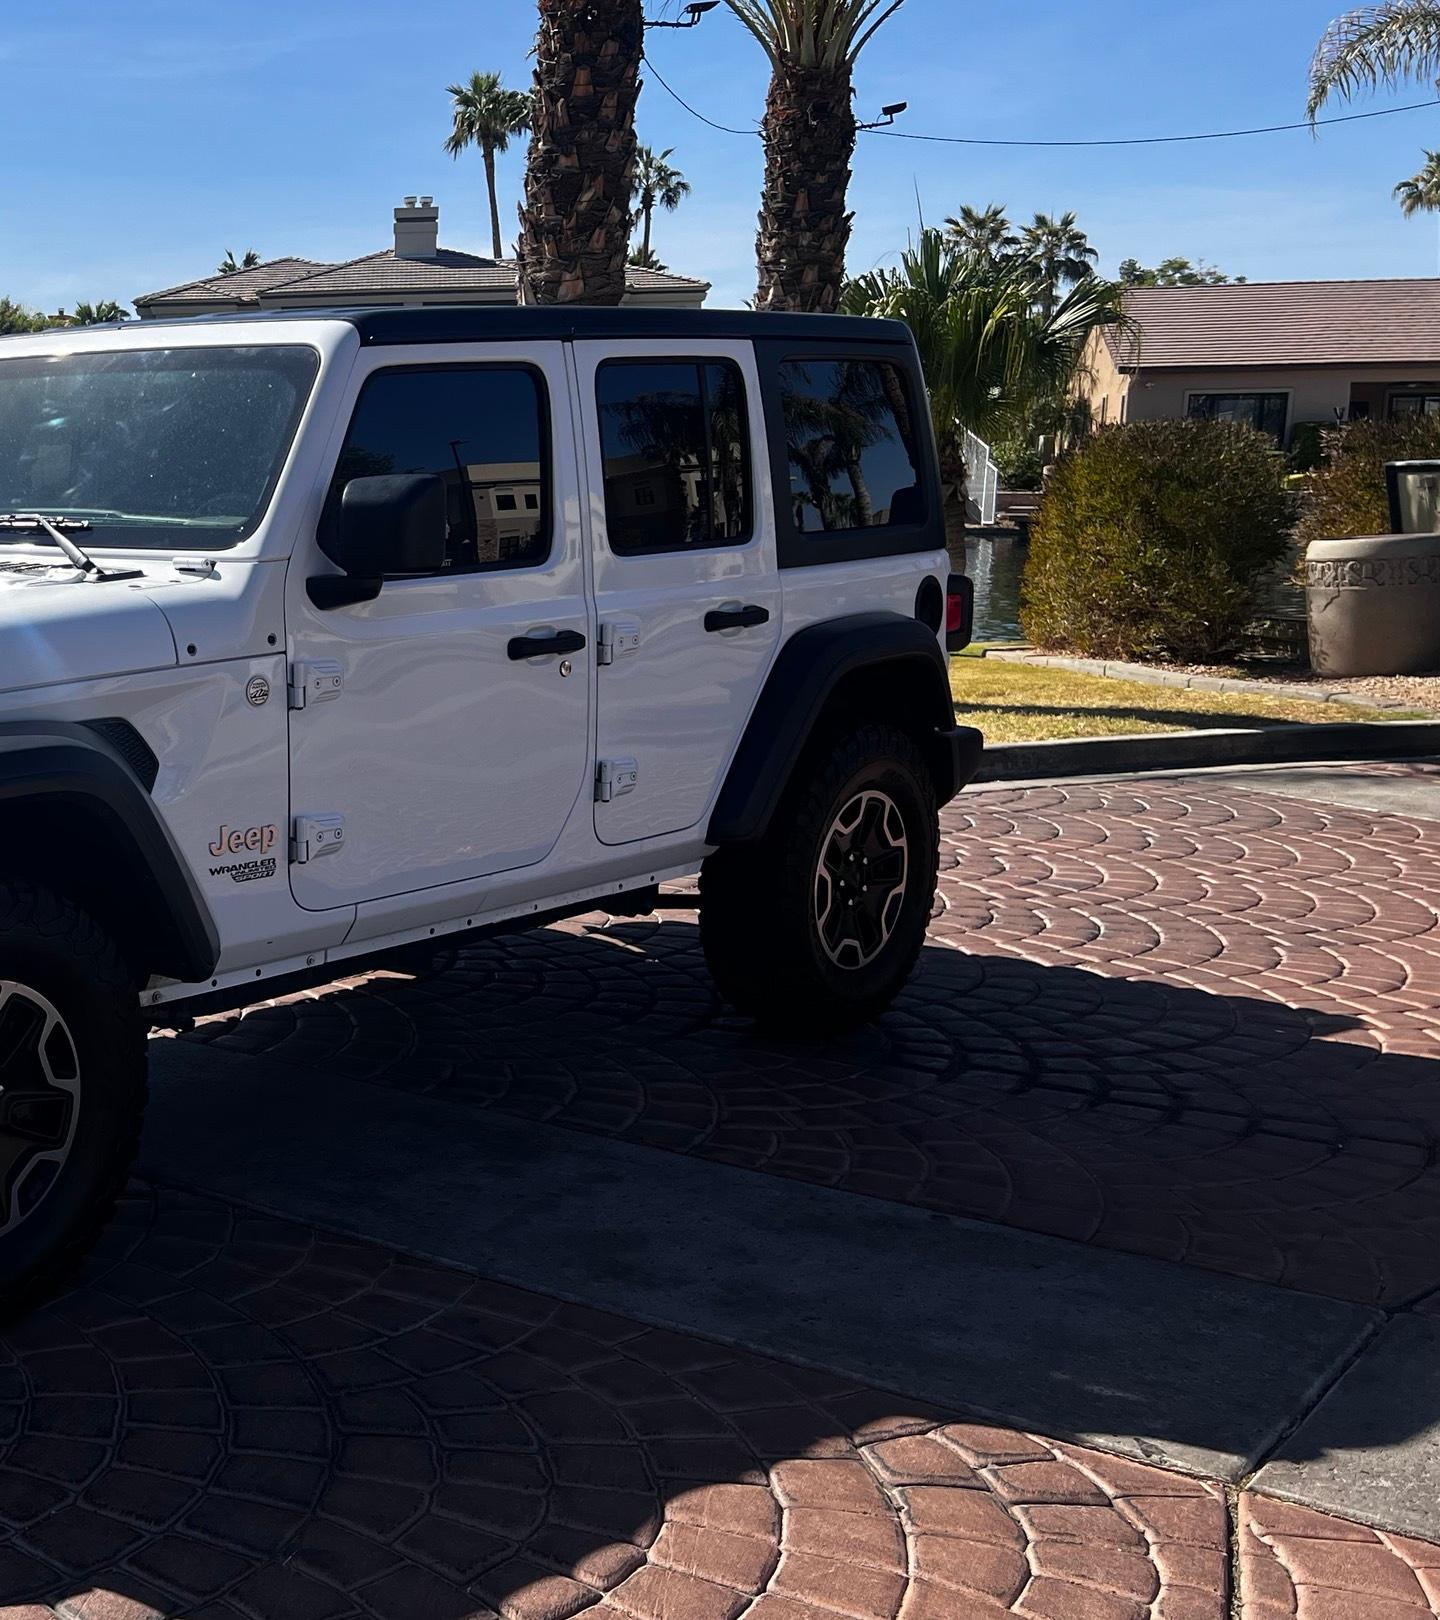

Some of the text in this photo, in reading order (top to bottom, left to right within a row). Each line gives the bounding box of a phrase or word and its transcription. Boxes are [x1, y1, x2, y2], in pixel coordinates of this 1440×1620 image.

[208, 823, 277, 857] Jeep
[209, 858, 276, 876] WRANGLER
[230, 865, 277, 877] UNLIMITED
[233, 870, 274, 882] SPORT
